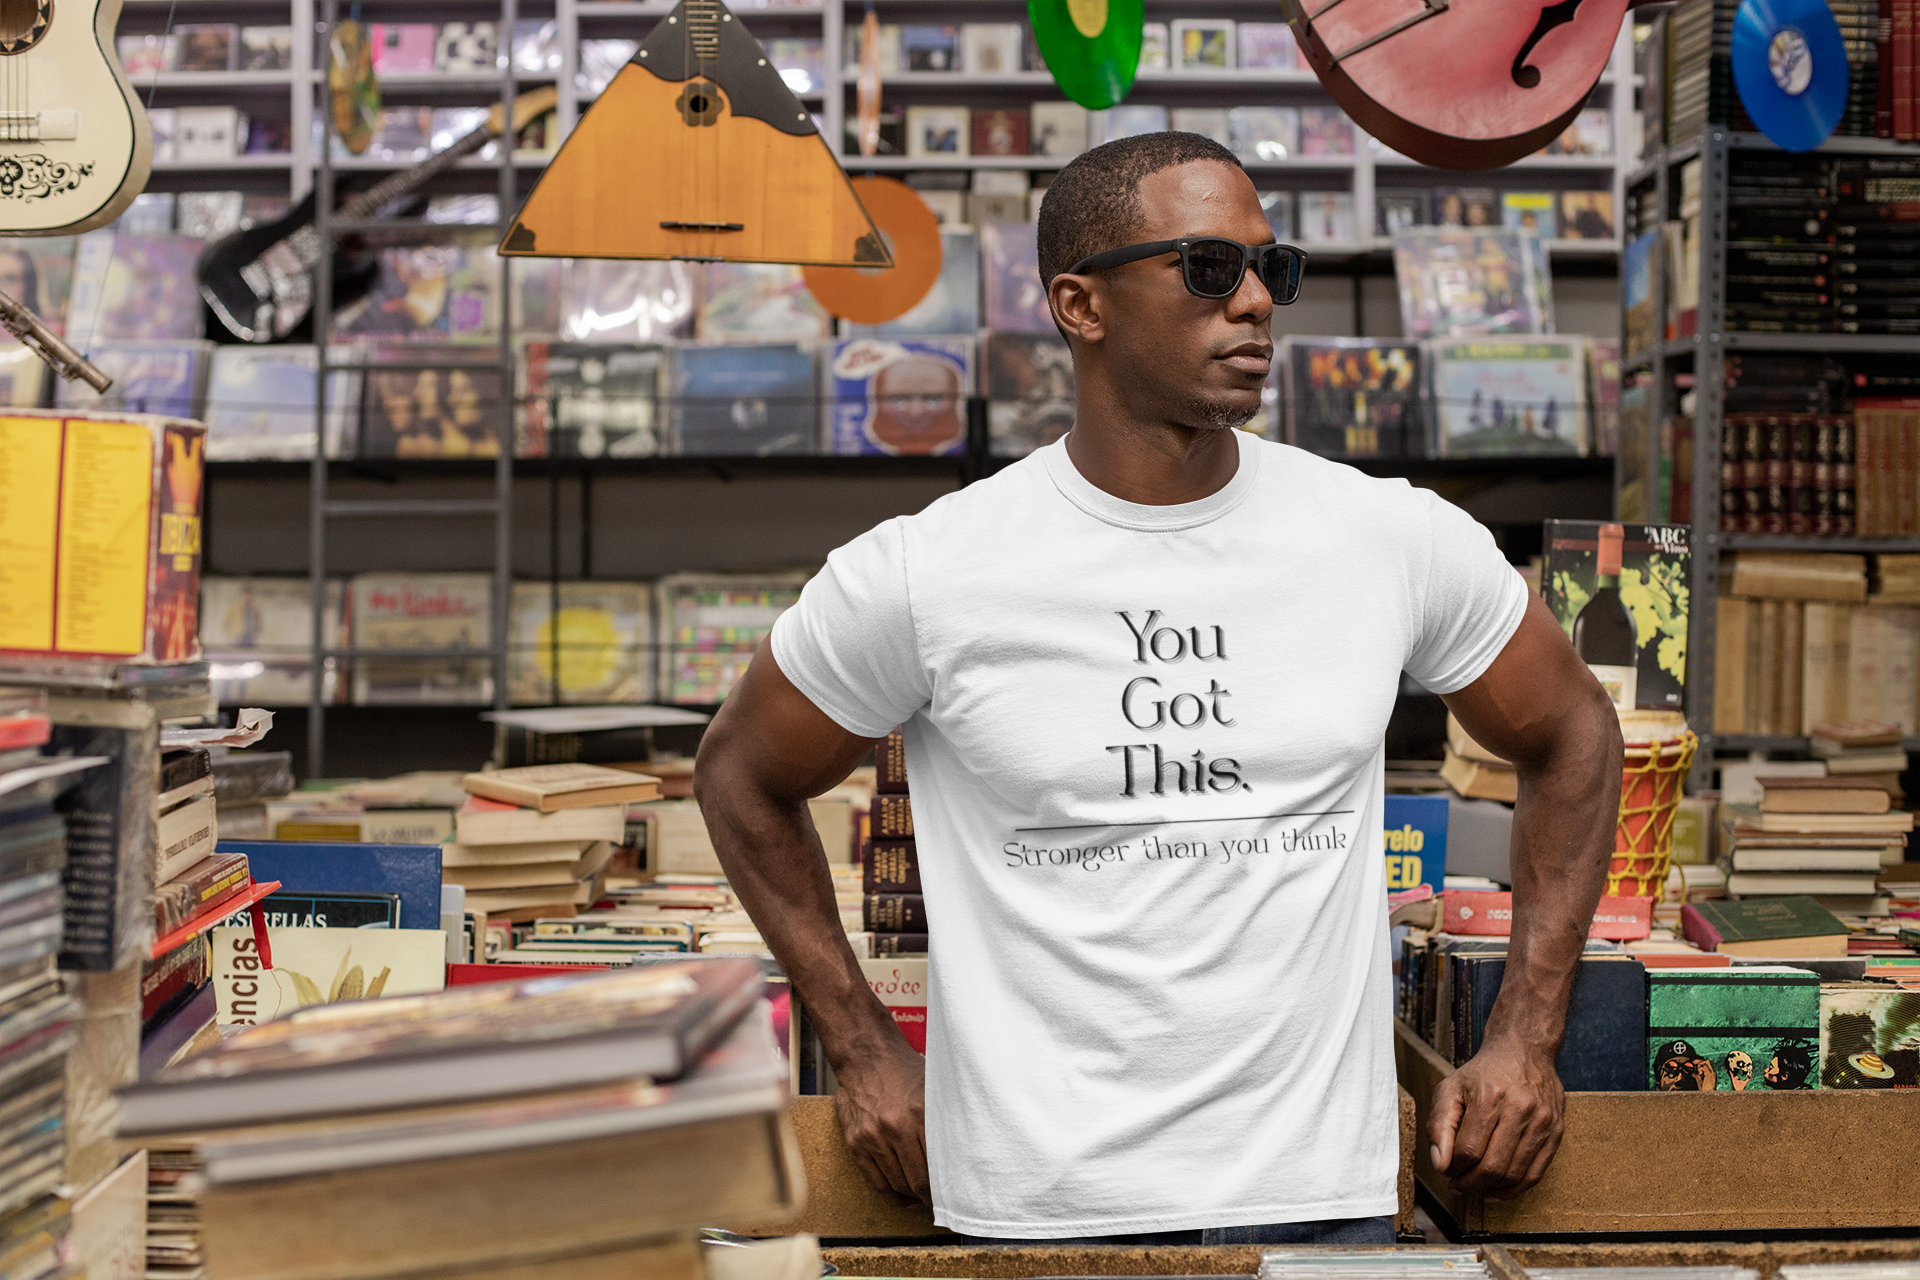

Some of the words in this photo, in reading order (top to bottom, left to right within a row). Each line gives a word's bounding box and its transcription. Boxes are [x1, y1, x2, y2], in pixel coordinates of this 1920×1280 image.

[1114, 610, 1230, 664] You
[1121, 676, 1238, 732] Got
[1105, 743, 1254, 797] This.
[1003, 841, 1130, 872] Stronger
[1142, 836, 1208, 861] than
[1219, 836, 1269, 865] you
[1280, 826, 1347, 853] think
[225, 911, 327, 927] ESRELLAS
